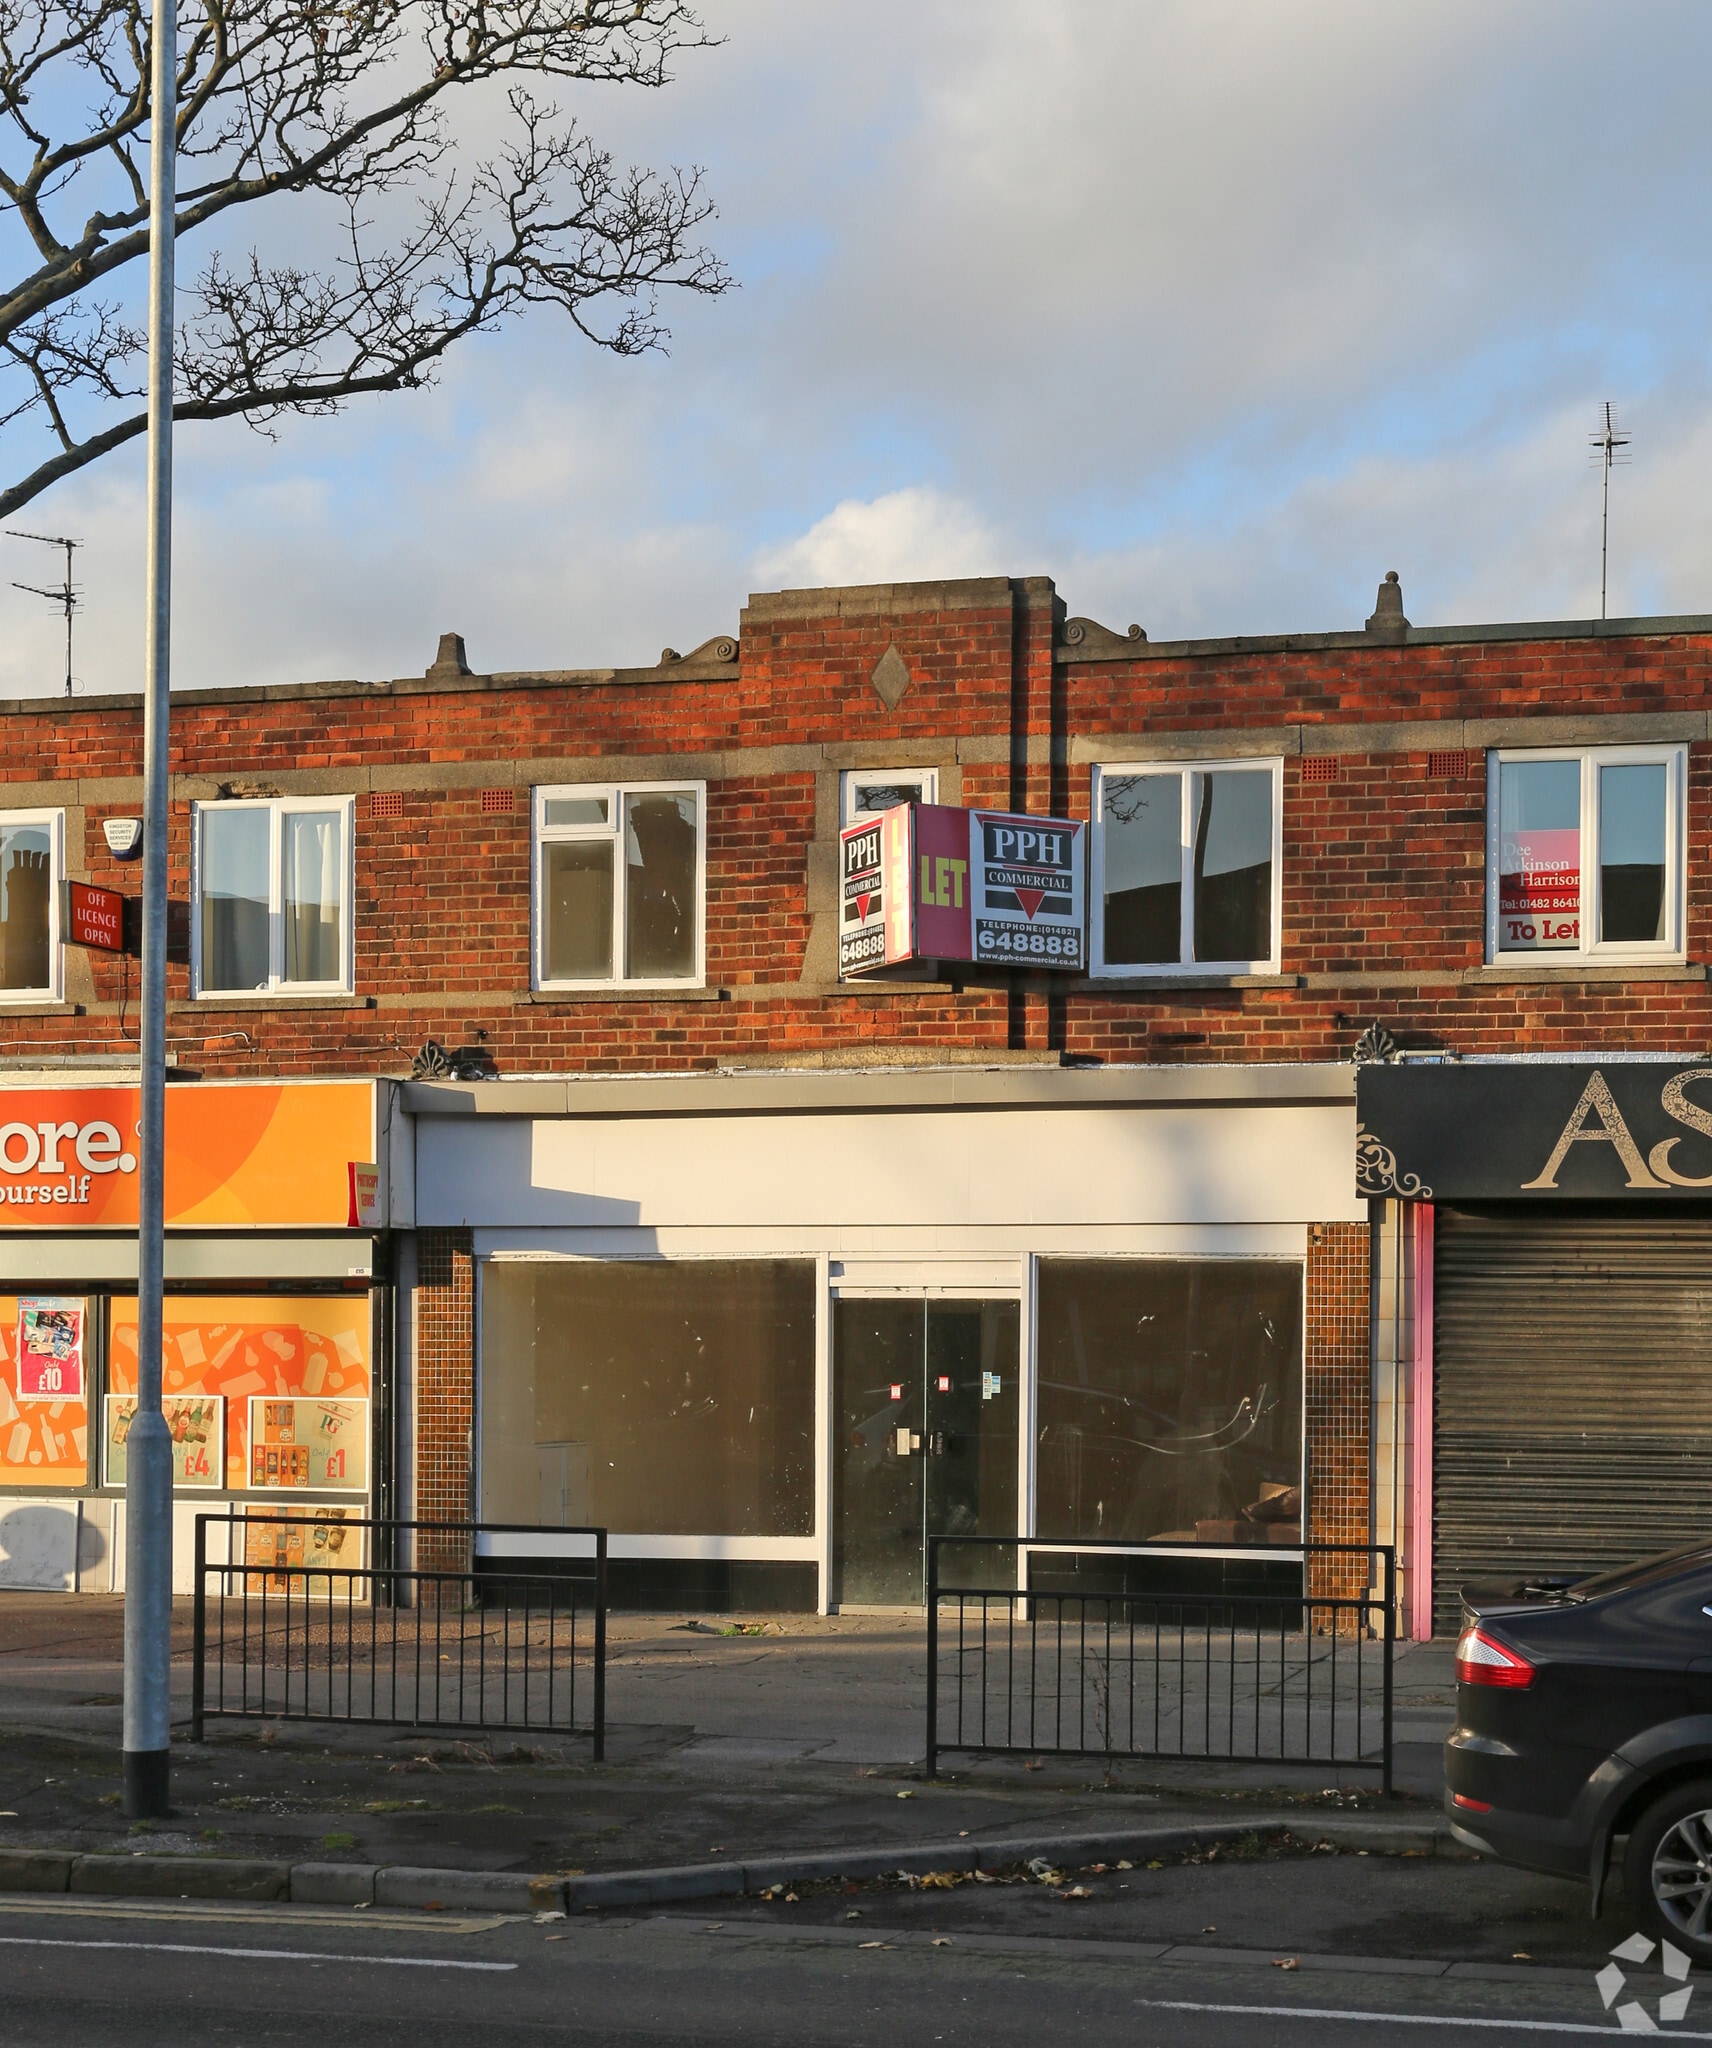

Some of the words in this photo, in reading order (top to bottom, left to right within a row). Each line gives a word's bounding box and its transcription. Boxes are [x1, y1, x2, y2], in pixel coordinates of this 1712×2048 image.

[847, 832, 879, 873] PPH
[992, 827, 1064, 865] PPH
[1503, 842, 1532, 857] Dee
[1502, 856, 1570, 872] Atkinson
[921, 855, 967, 909] LET
[988, 871, 1069, 889] COMMERCIAL
[87, 892, 106, 907] OFF
[1501, 899, 1519, 910] Tel:
[1519, 898, 1550, 909] 01482
[77, 907, 117, 929] LICENCE
[84, 927, 111, 945] OPEN
[1507, 920, 1537, 941] To
[1542, 919, 1580, 940] Let
[841, 933, 885, 963] 648888
[978, 930, 1079, 956] 648888
[978, 951, 1079, 967] www.pph-commercial.co.uk
[1521, 1068, 1712, 1190] AS
[39, 1367, 62, 1392] £10
[319, 1414, 341, 1435] PG
[185, 1446, 210, 1477] £4
[311, 1446, 330, 1461] Only
[326, 1448, 345, 1478] £1
